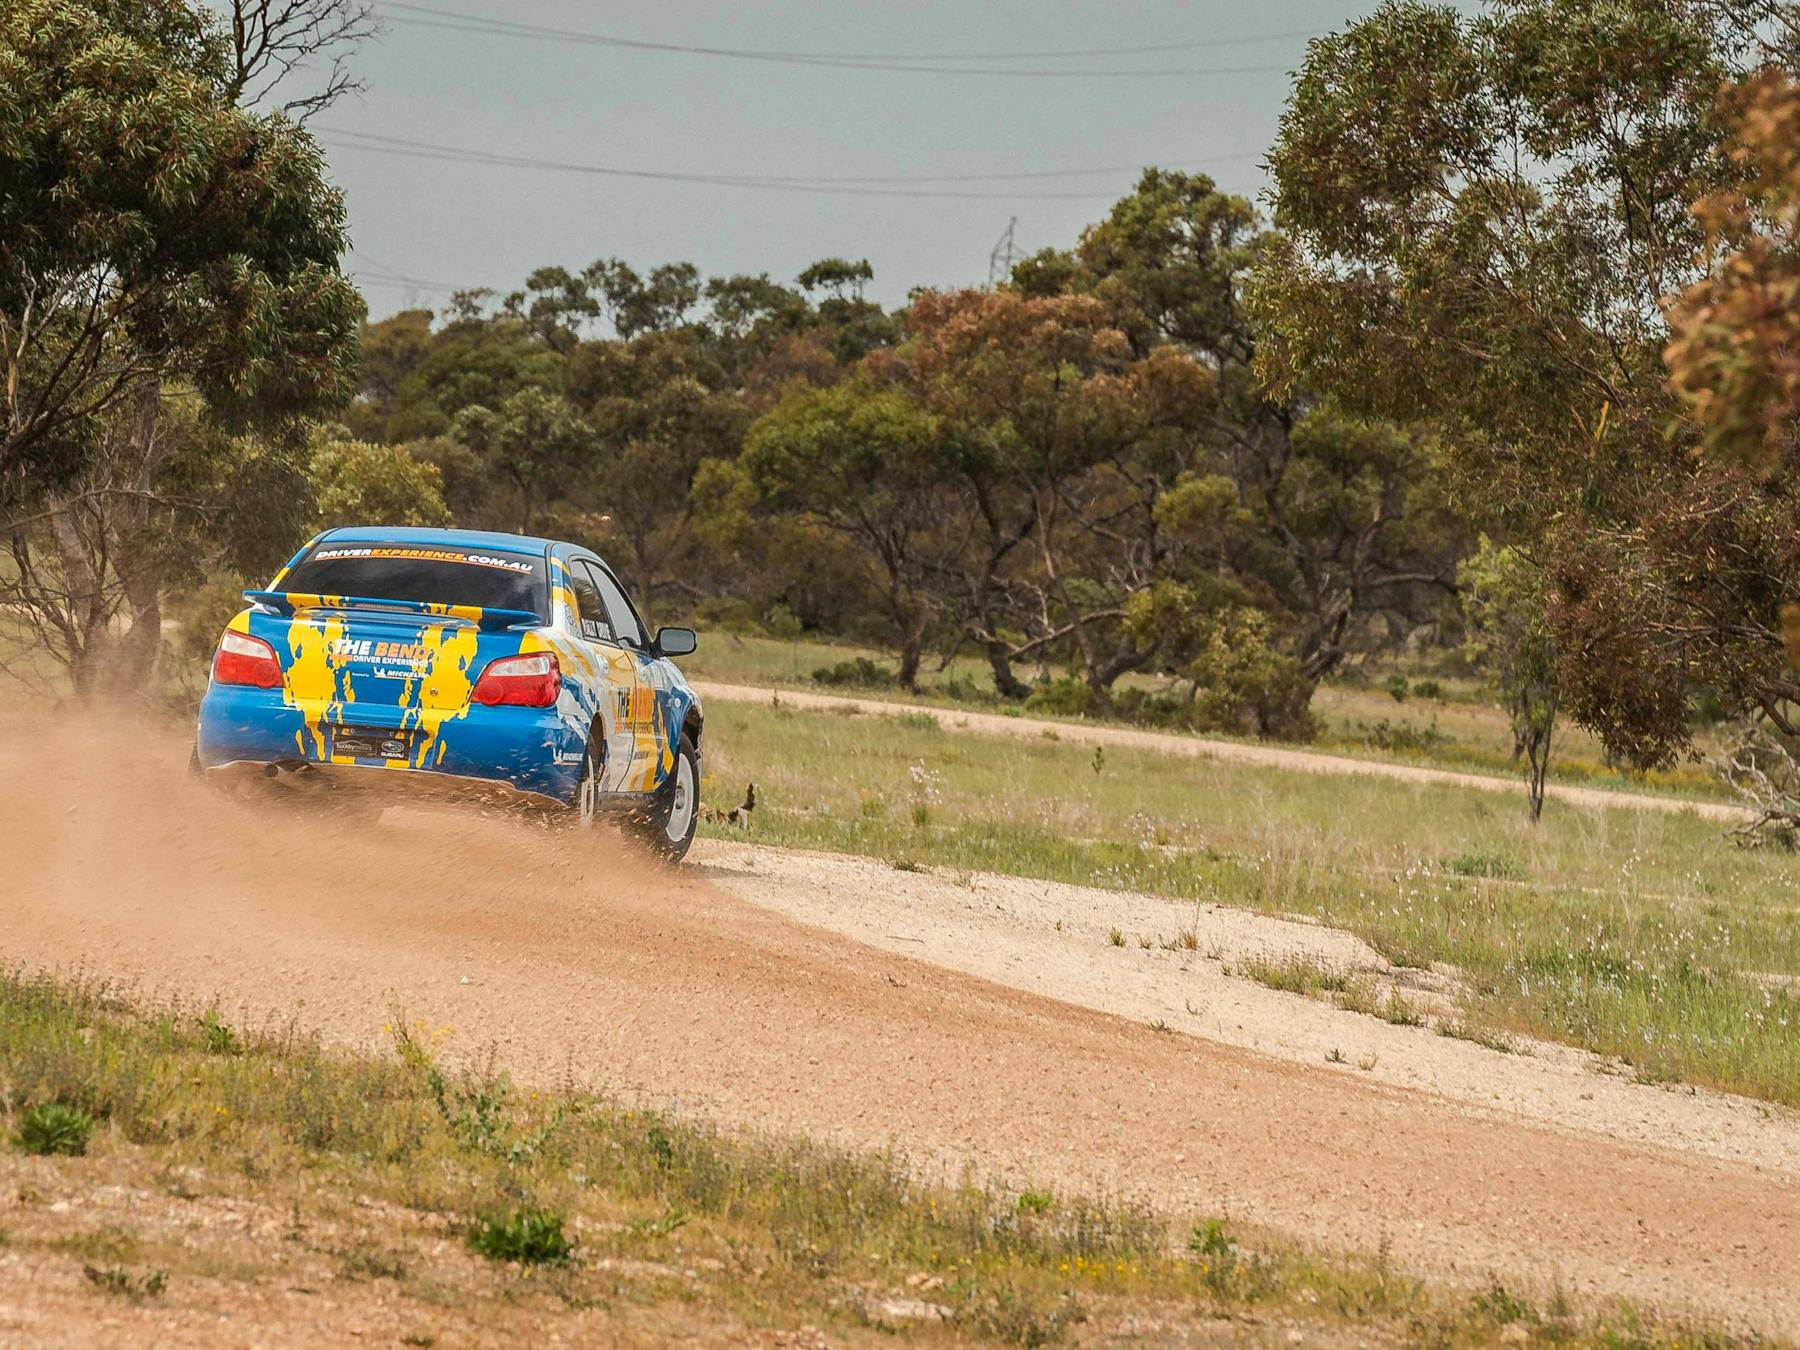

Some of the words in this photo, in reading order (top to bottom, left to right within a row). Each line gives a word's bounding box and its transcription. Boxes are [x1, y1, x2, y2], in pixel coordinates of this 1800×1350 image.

[315, 548, 533, 572] DRIVEREXPERIENCE.COM.AU
[335, 639, 372, 655] THE
[374, 642, 428, 660] BEND
[353, 655, 380, 664] DRIVER
[382, 657, 429, 667] EXPERIENCE
[387, 670, 430, 679] MICHELIN
[617, 687, 630, 718] THE
